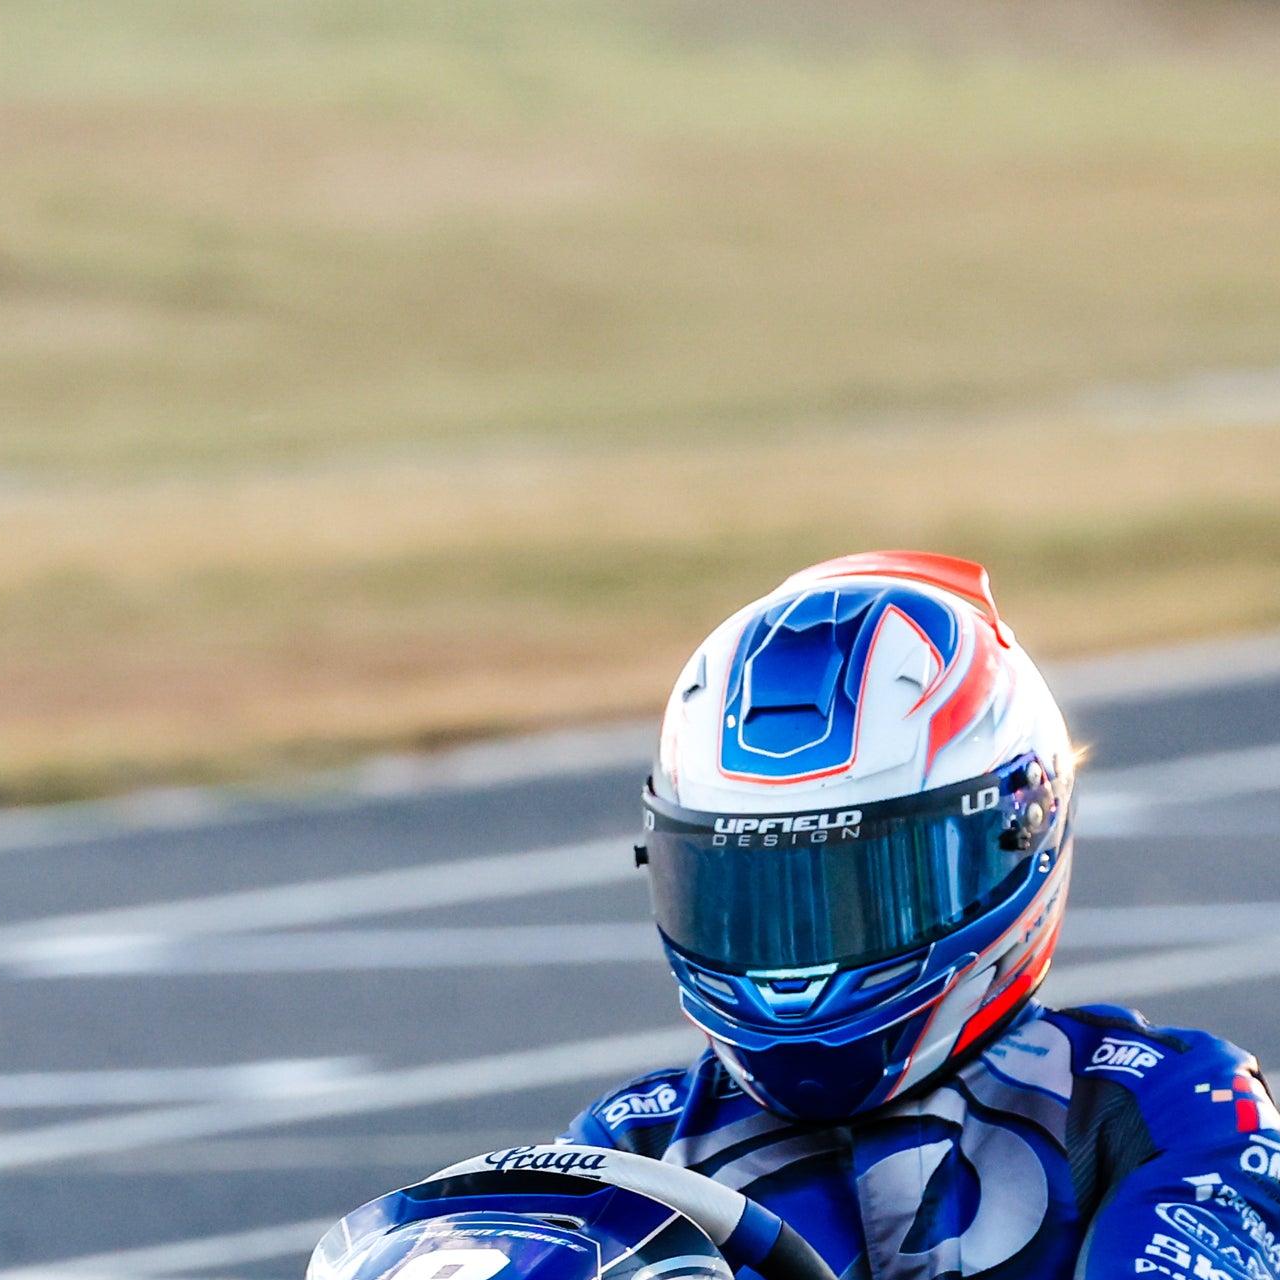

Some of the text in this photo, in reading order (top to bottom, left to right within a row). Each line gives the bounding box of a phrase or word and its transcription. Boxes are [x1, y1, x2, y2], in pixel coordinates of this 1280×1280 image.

[714, 809, 863, 835] UPFIELD
[712, 826, 861, 847] DESIGN
[1091, 1043, 1158, 1068] OMP
[605, 1087, 677, 1123] OMP
